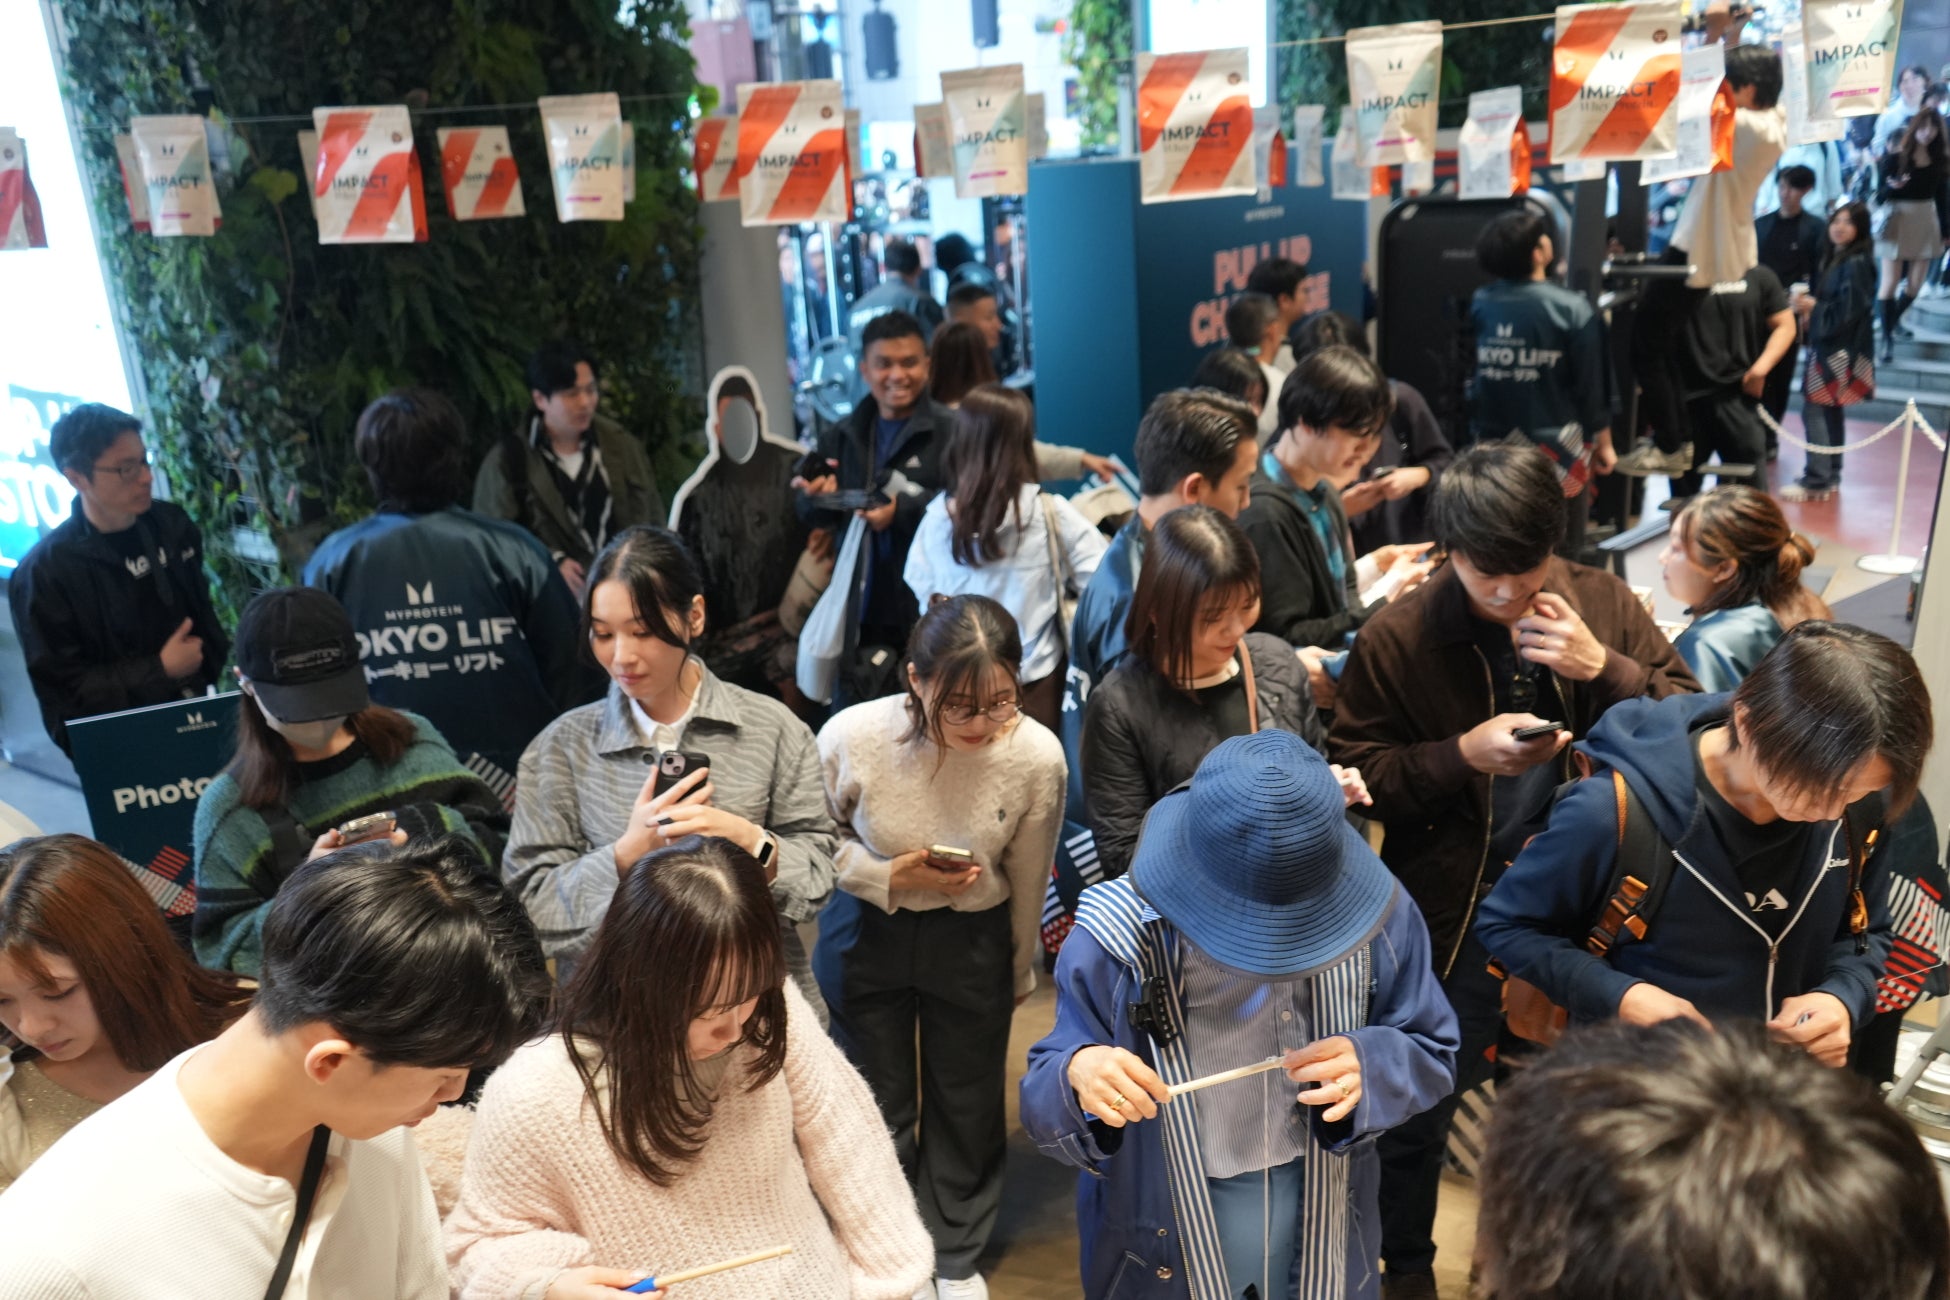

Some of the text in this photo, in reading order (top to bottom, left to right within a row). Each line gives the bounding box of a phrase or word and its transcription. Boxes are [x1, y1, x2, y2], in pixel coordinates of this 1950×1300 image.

[1580, 82, 1656, 99] IMPACT
[1362, 93, 1428, 113] IMPACT
[1161, 121, 1230, 141] IMPACT
[757, 152, 821, 168] IMPACT
[333, 174, 388, 188] IMPACT
[385, 605, 463, 621] MYPROTEIN
[363, 651, 504, 684] トーキョー リフト
